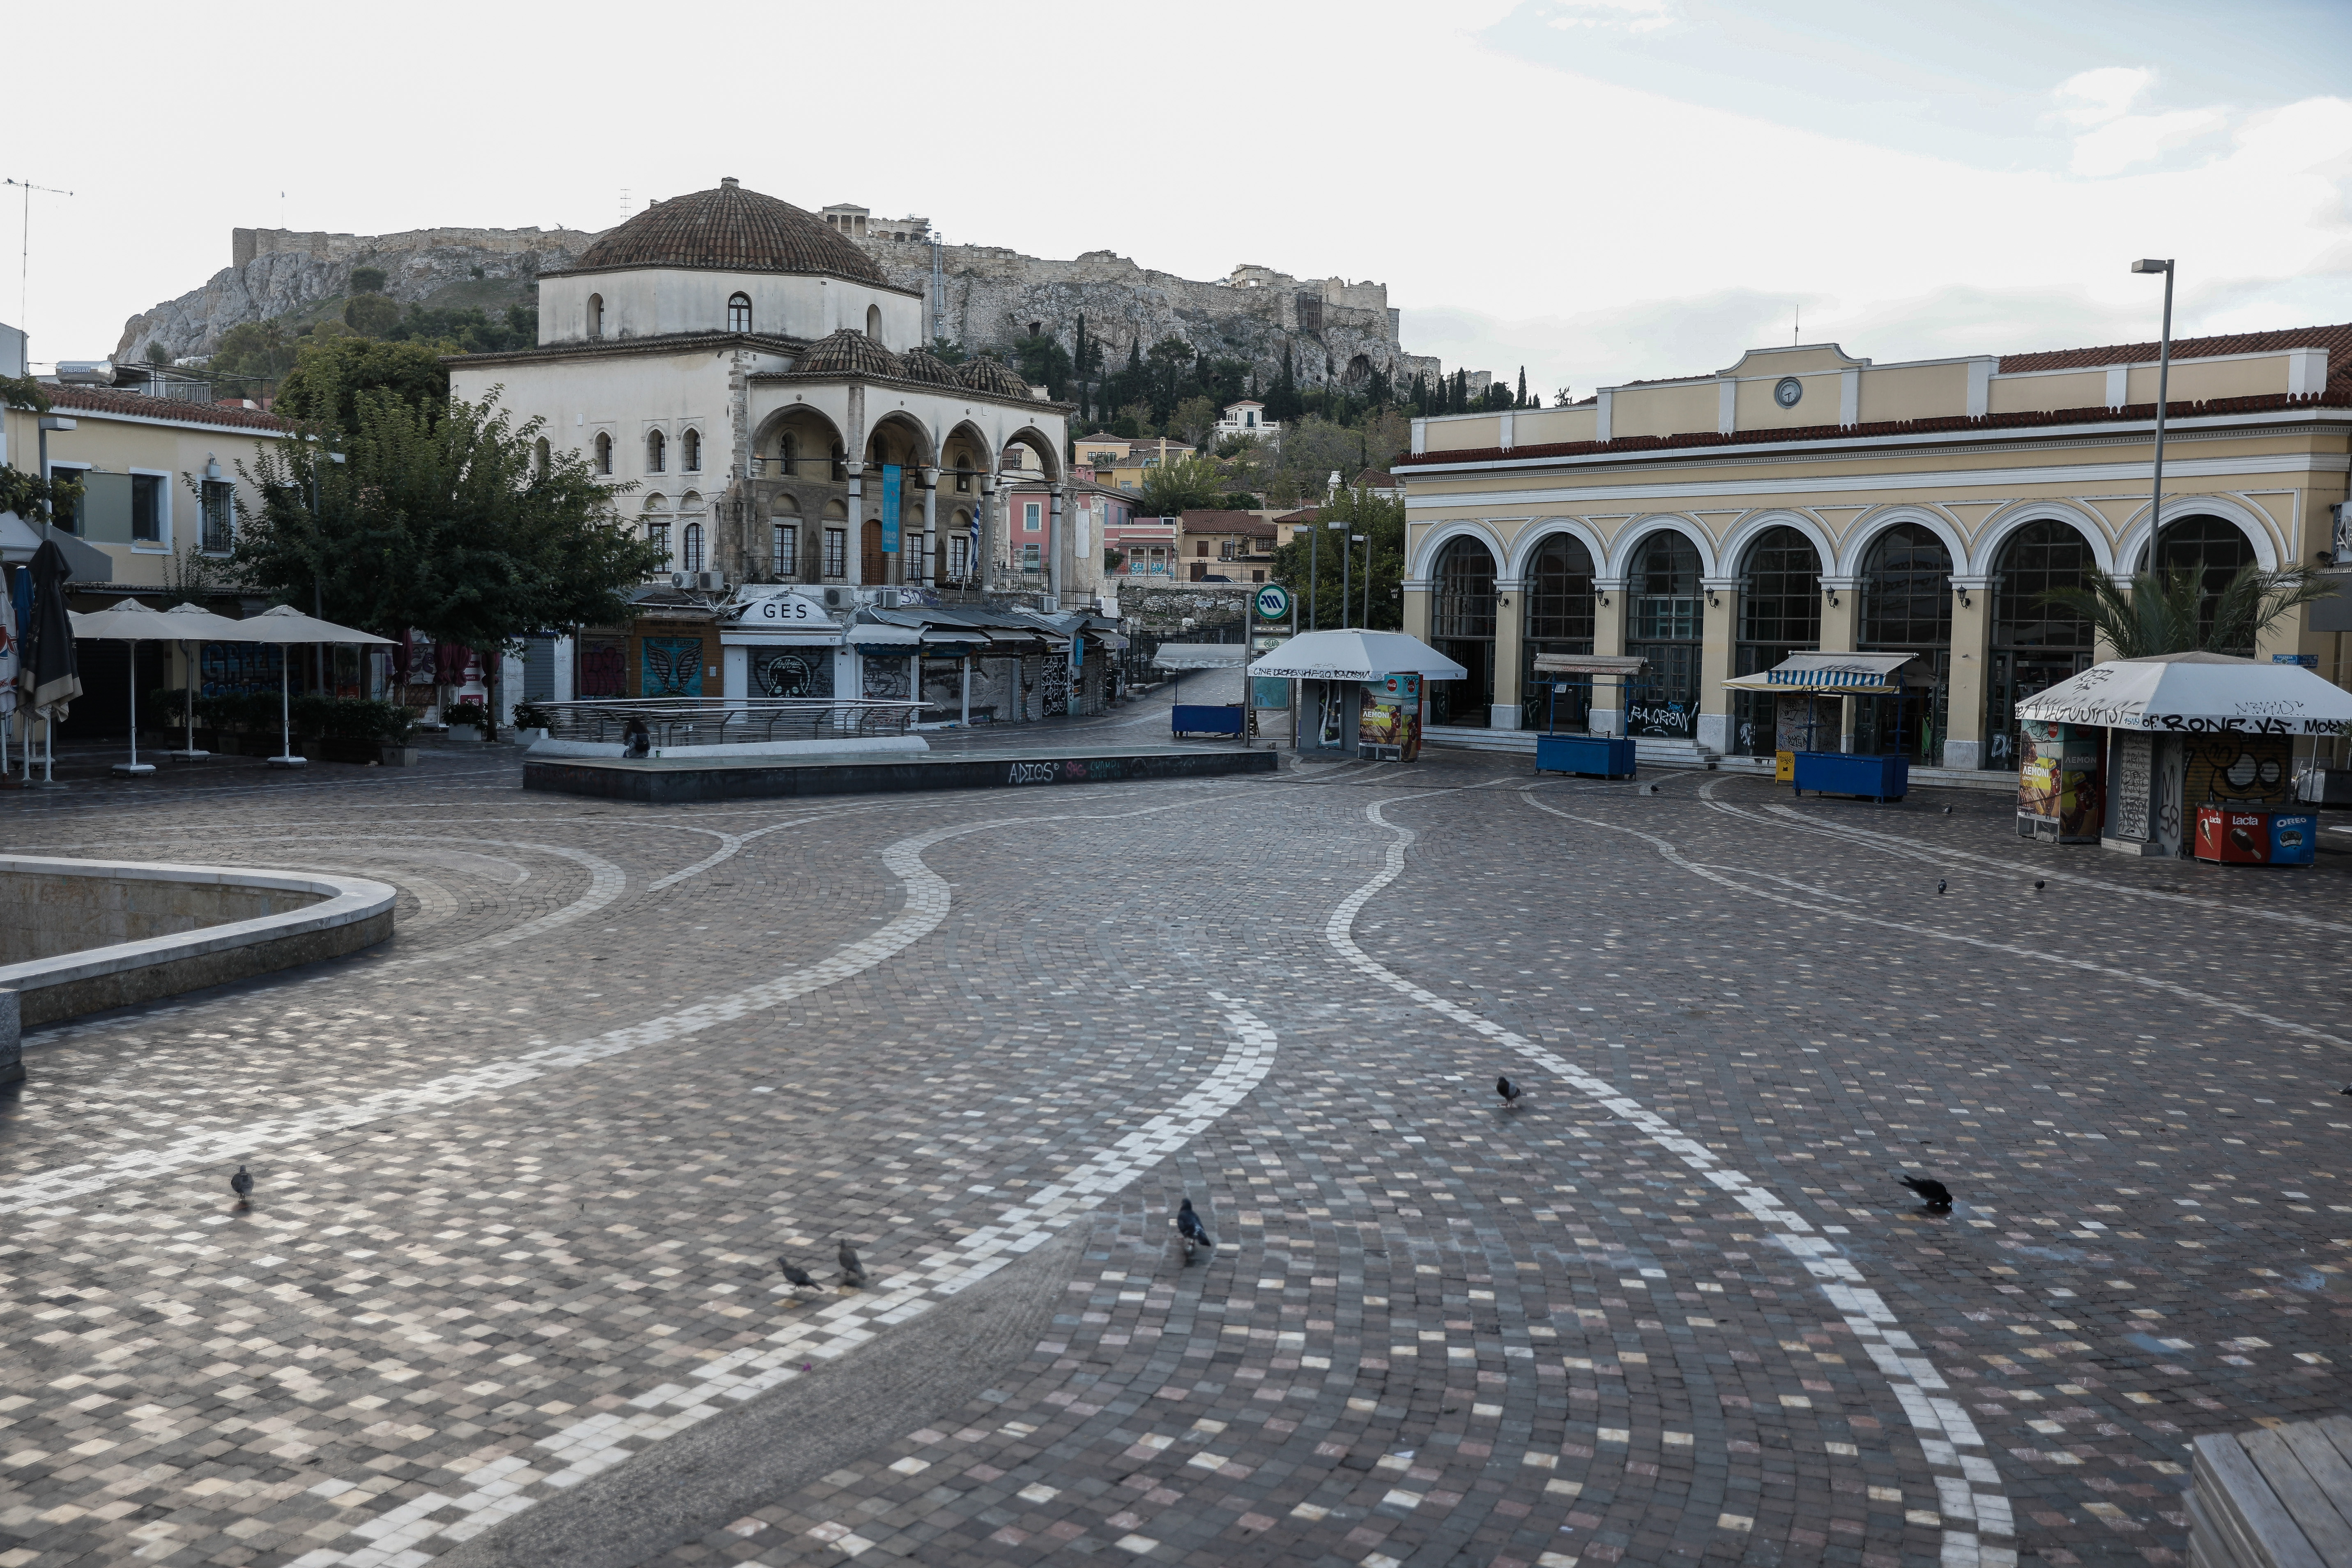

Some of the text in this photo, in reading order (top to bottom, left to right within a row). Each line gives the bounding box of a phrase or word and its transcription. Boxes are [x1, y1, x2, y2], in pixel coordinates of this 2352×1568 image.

[764, 603, 807, 618] GES
[1009, 762, 1054, 784] ADIOS
[2276, 817, 2307, 828] OREO
